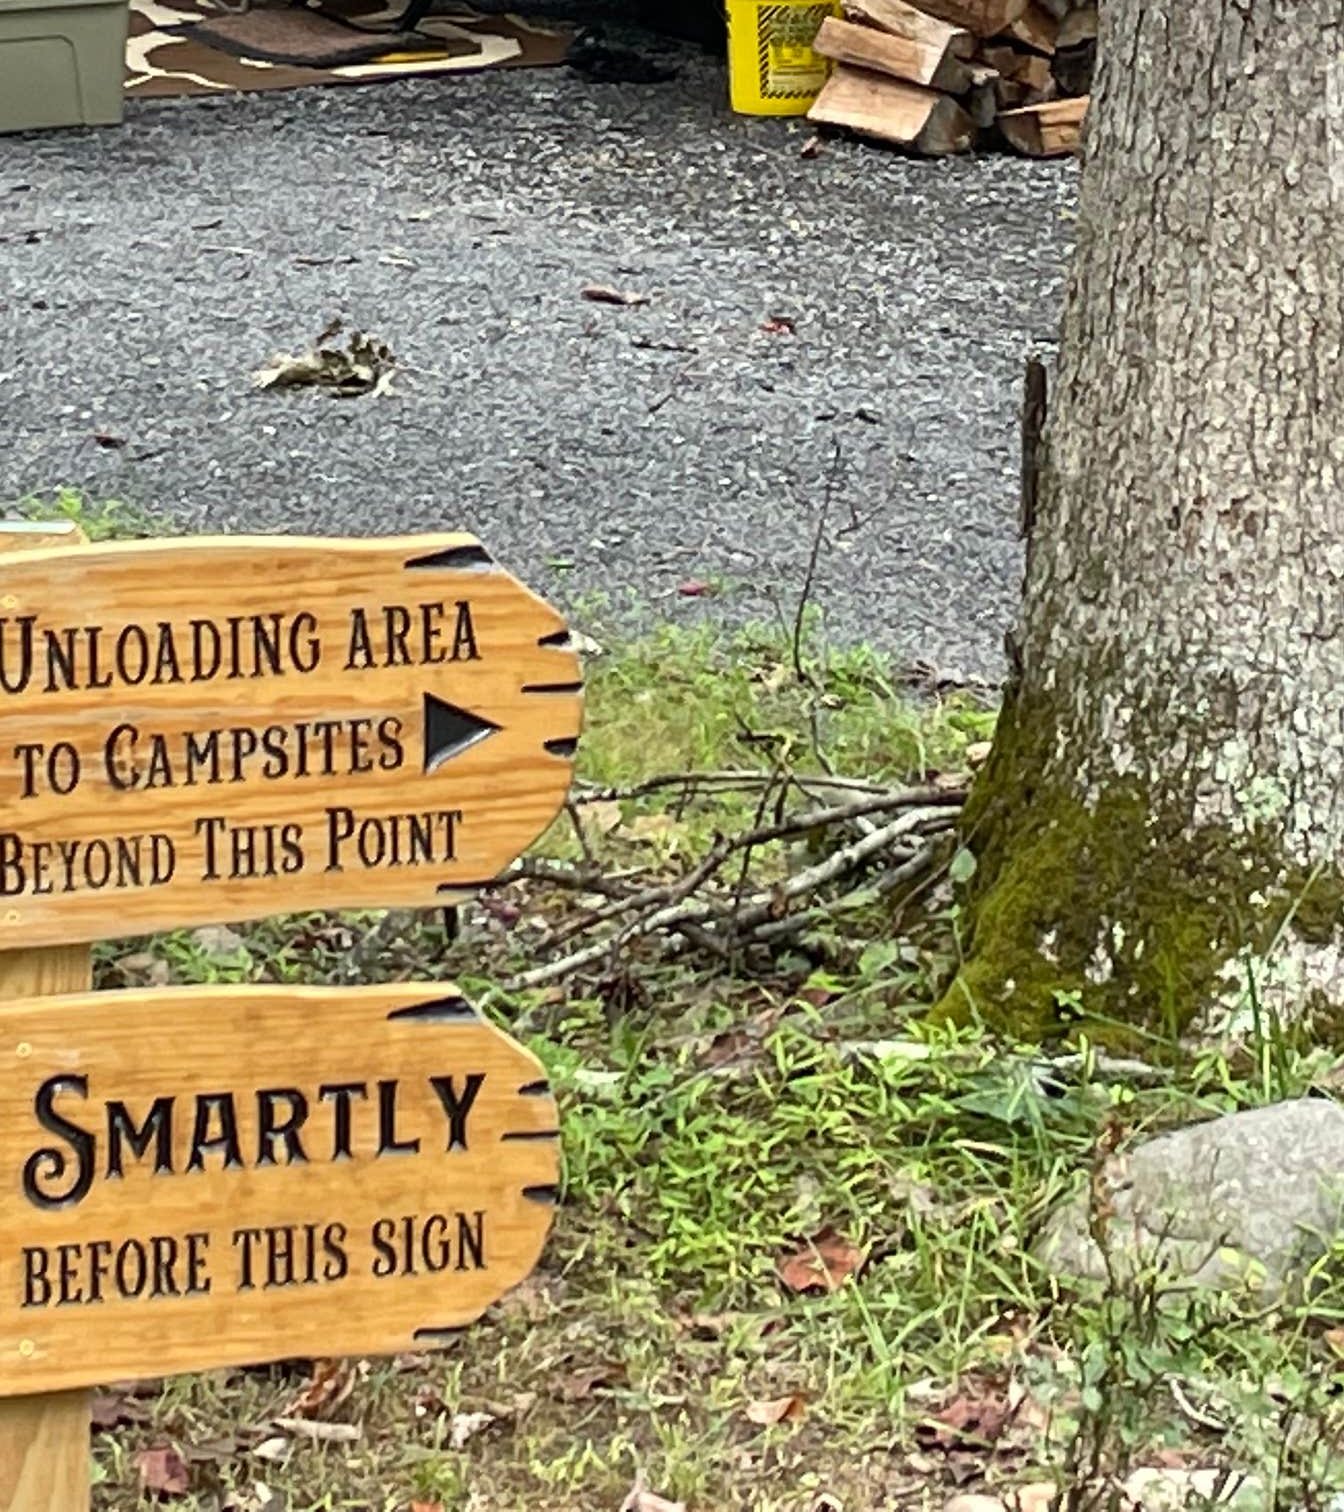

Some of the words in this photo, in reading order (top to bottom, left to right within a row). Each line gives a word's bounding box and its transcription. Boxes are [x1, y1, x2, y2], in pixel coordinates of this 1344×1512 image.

[344, 600, 481, 670] AREA
[13, 742, 81, 798] TO
[104, 717, 403, 791] CAMPSITES
[195, 817, 304, 880] THIS
[325, 807, 462, 871] POINT
[23, 1073, 485, 1208] SMARTLY
[21, 1233, 211, 1308] BEFORE
[233, 1223, 348, 1289] THIS
[372, 1211, 485, 1277] SIGN
